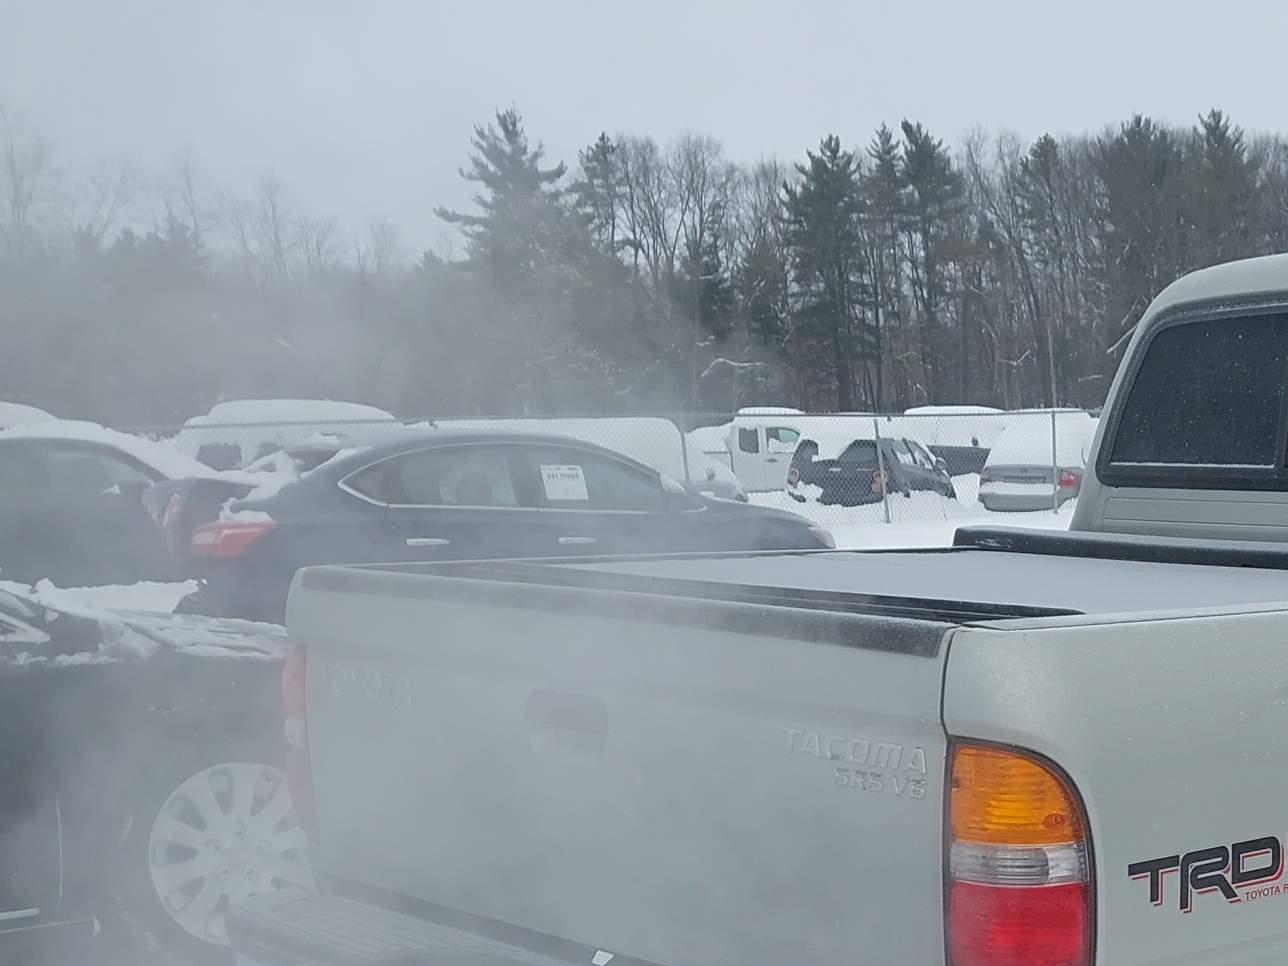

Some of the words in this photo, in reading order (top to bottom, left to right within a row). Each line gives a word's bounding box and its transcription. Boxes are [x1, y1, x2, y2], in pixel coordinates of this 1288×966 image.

[782, 727, 928, 774] TACOMA
[892, 771, 927, 800] V6
[1127, 836, 1284, 914] TRD
[1244, 886, 1281, 901] TOYOTA
